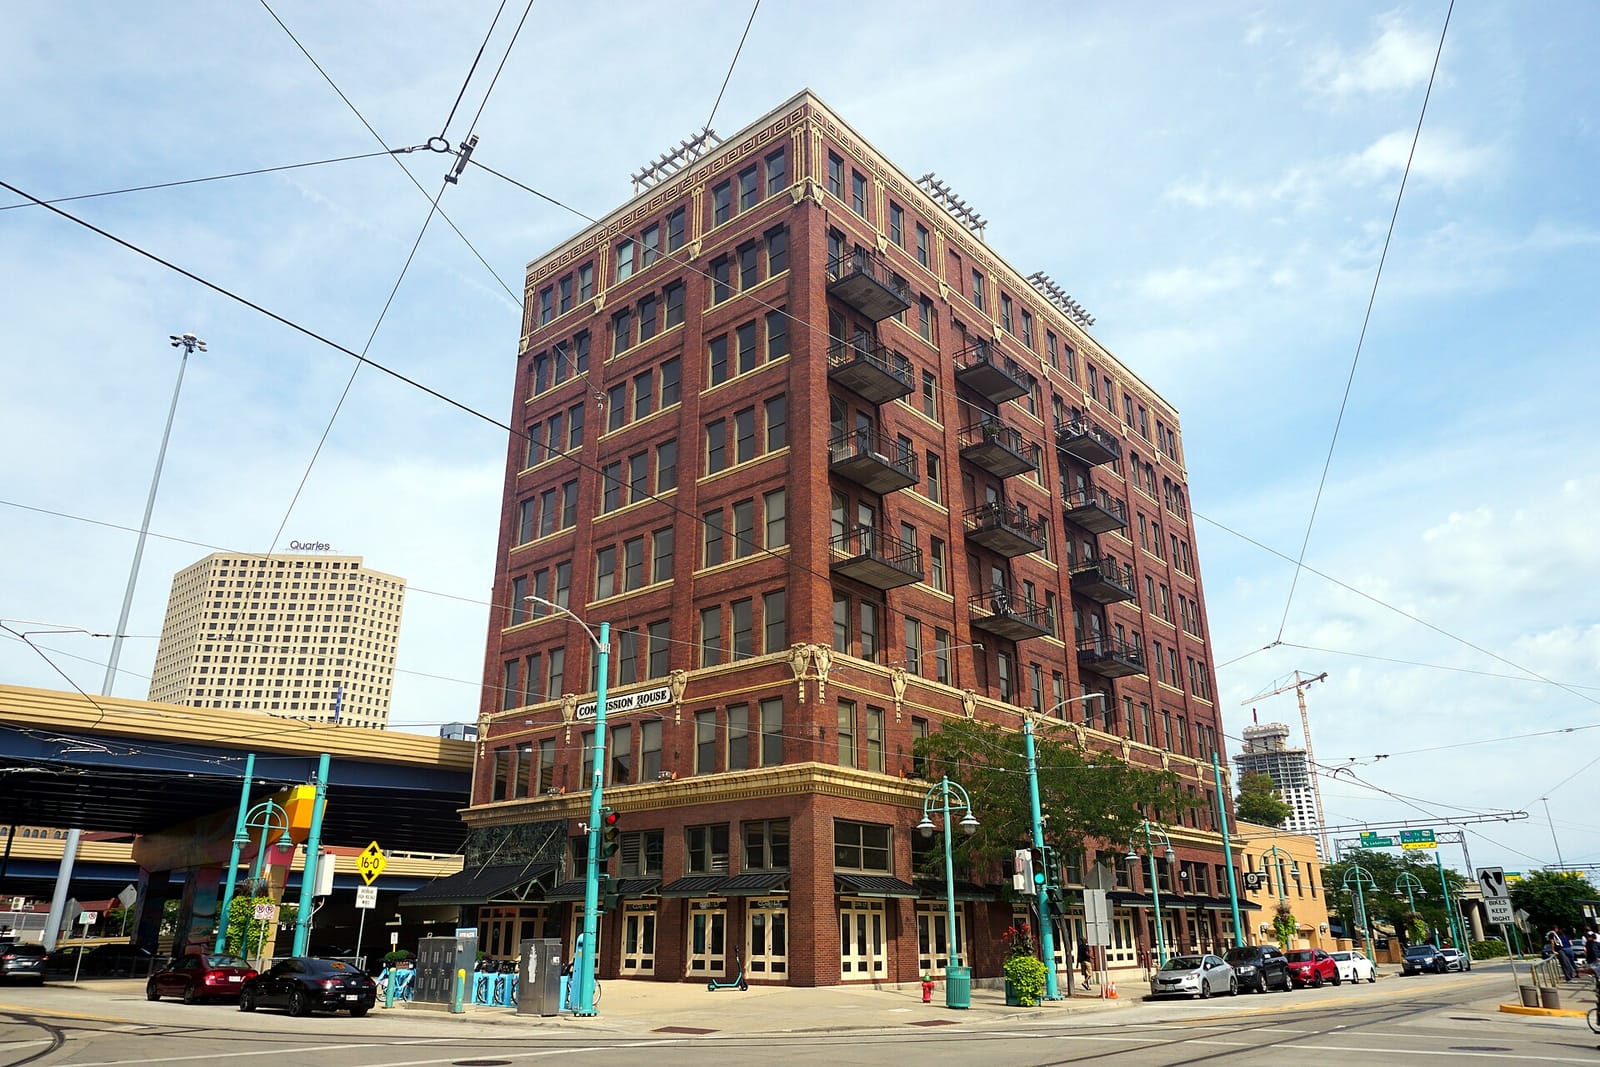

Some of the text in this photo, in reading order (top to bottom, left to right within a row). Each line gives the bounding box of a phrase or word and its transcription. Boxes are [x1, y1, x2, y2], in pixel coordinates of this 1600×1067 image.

[290, 540, 330, 551] Quarles
[579, 690, 667, 716] COMISSION HOUSE
